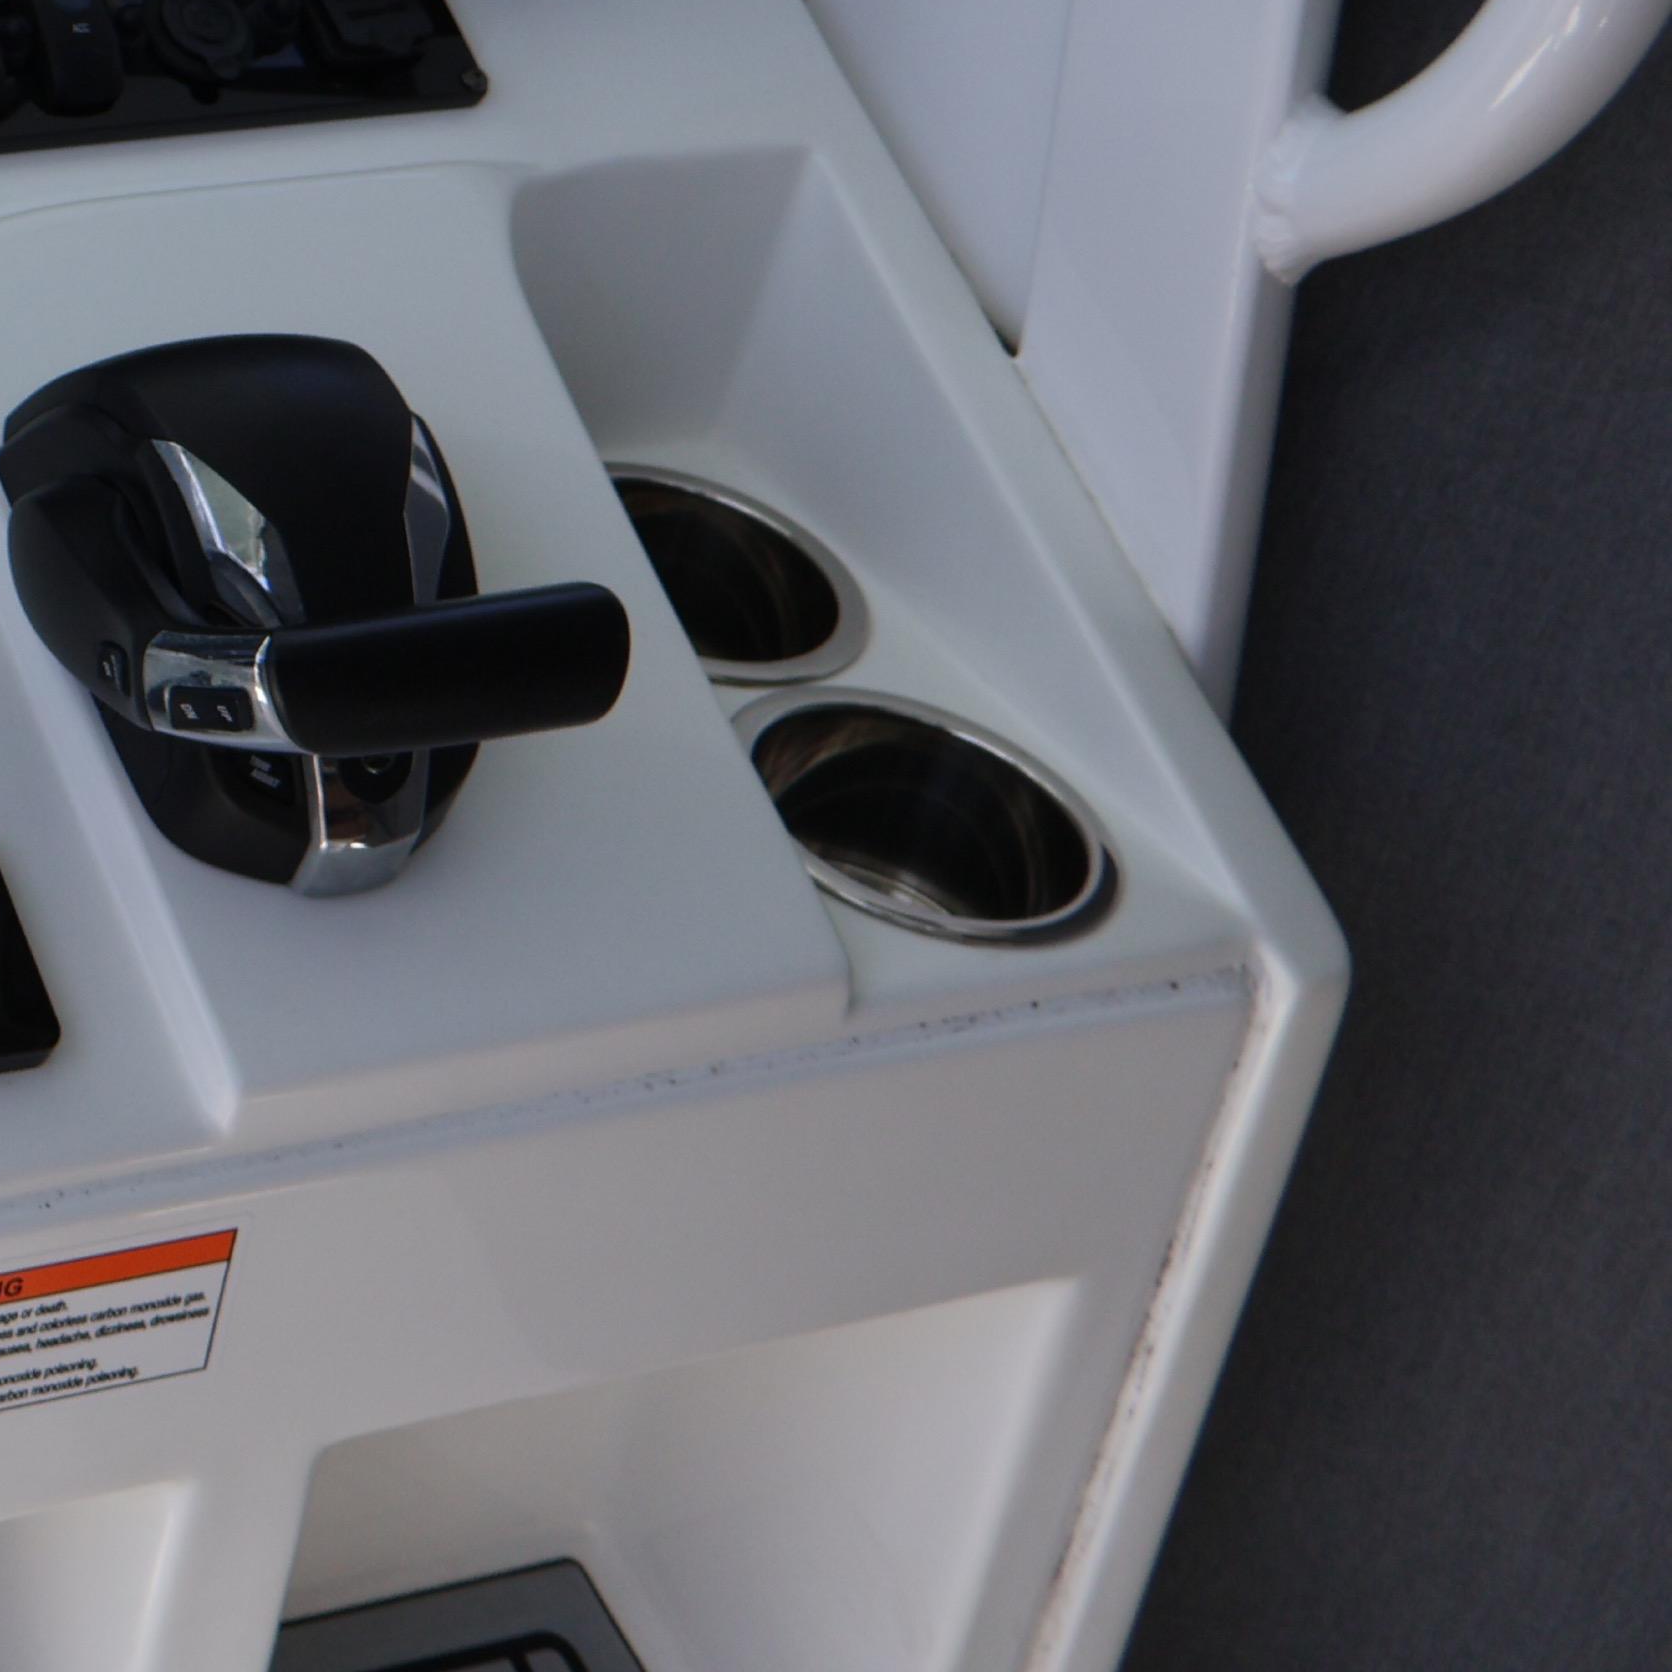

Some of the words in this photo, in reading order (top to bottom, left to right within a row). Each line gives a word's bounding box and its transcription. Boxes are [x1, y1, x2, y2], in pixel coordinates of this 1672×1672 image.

[16, 1322, 38, 1336] and
[90, 1306, 128, 1322] carbon
[130, 1296, 182, 1313] monoxide
[21, 1307, 33, 1319] or
[31, 1375, 84, 1395] monoxide
